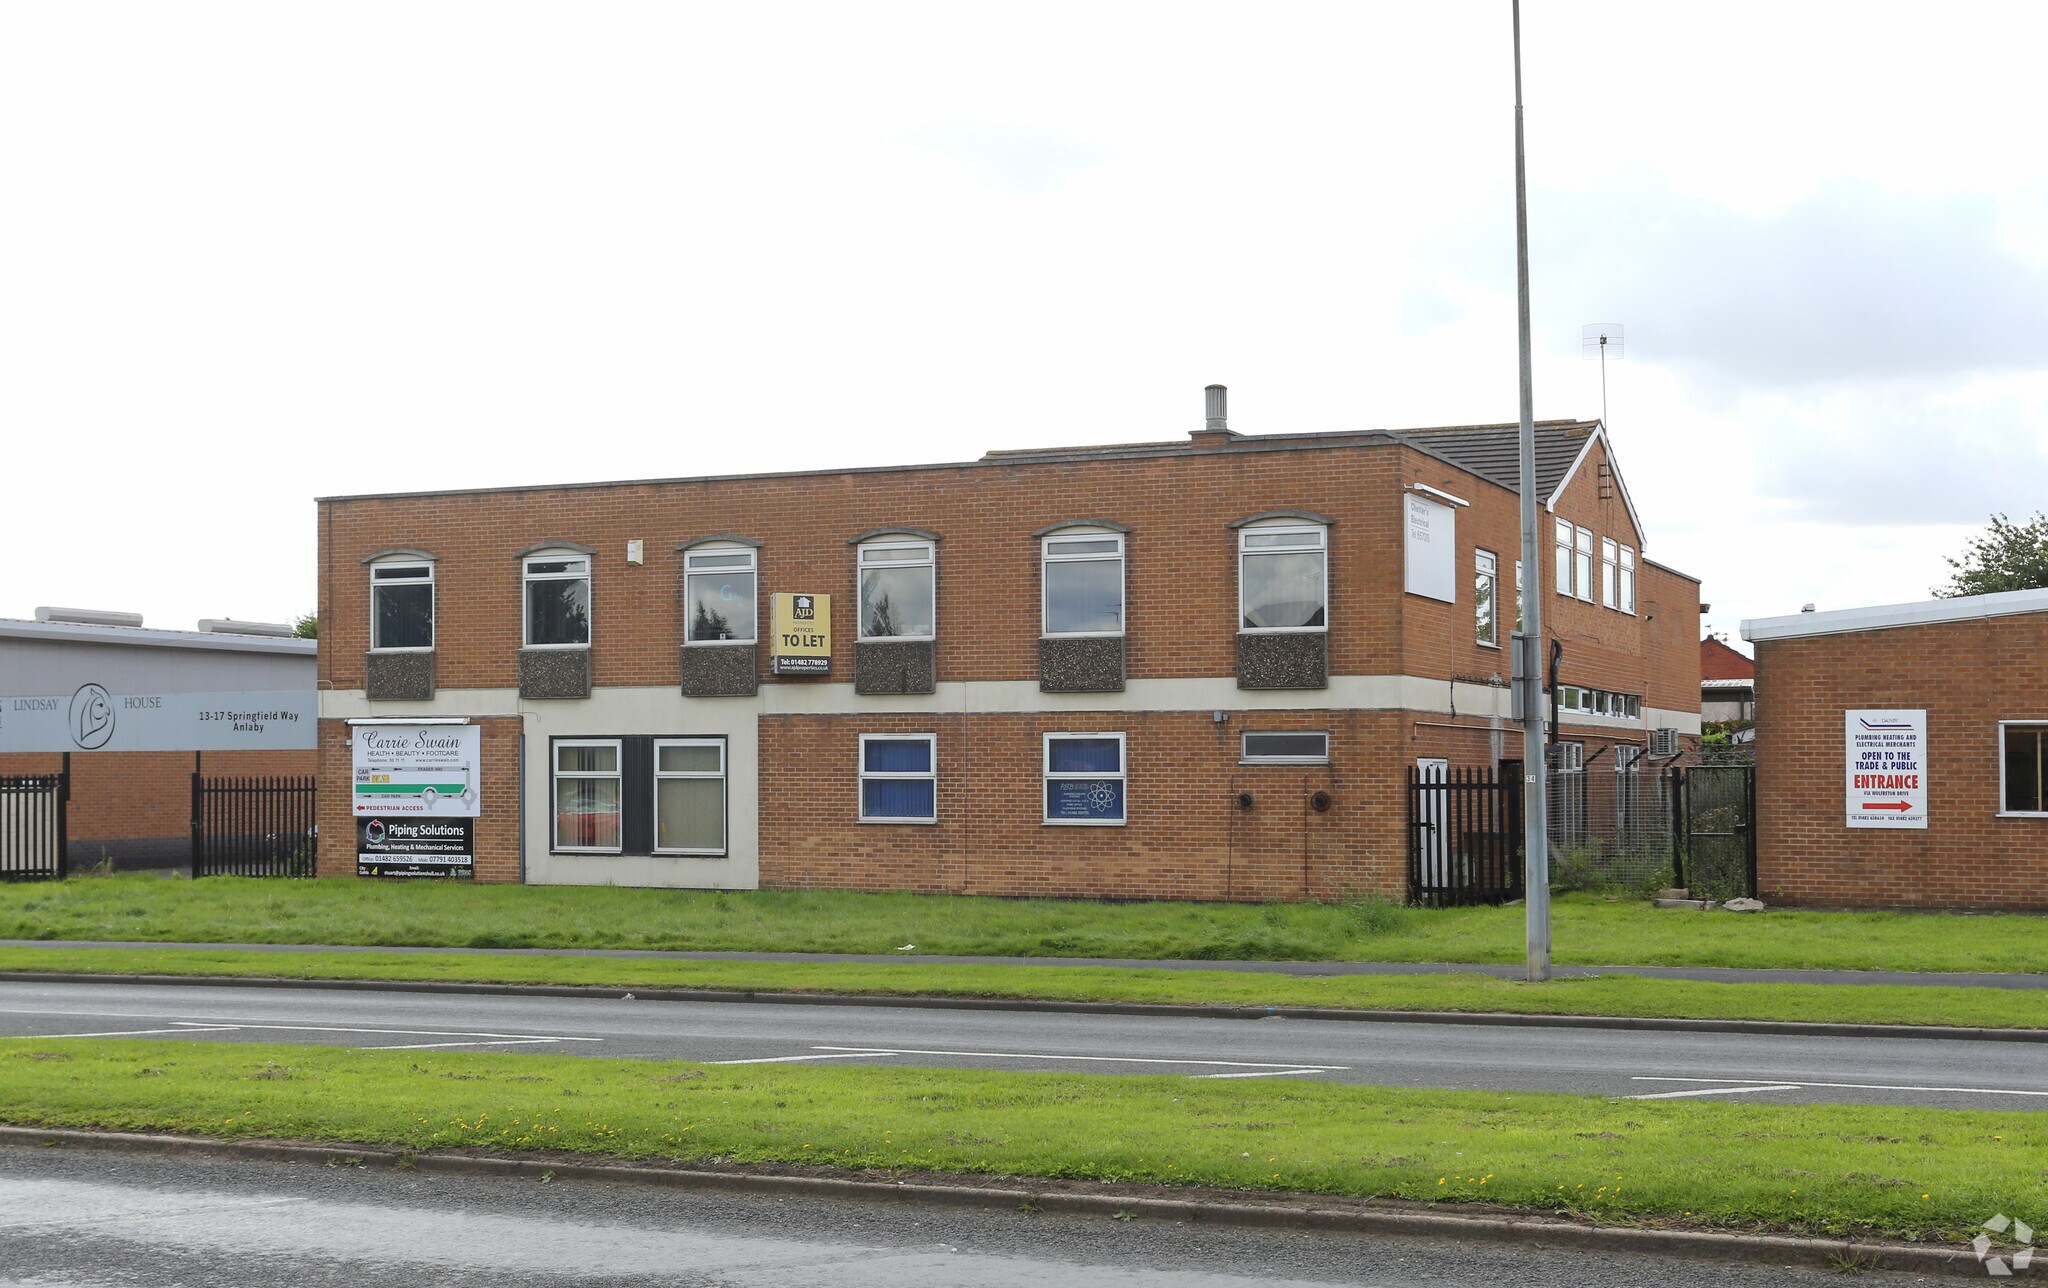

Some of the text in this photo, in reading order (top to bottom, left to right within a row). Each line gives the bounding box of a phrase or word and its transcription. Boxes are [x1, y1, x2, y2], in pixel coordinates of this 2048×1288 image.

[794, 608, 813, 618] AJD
[782, 635, 825, 647] TO LET
[14, 697, 162, 711] LINDSAY HOUSE
[199, 711, 299, 722] 13-17 Springfield Way
[233, 722, 264, 733] Anlaby
[362, 730, 461, 748] Carrie Swain
[1862, 752, 1910, 760] OPEN TO THE
[1855, 762, 1917, 770] TRADE & PUBLIC
[1854, 775, 1918, 789] ENTRANCE
[389, 824, 464, 837] Piping Solutions
